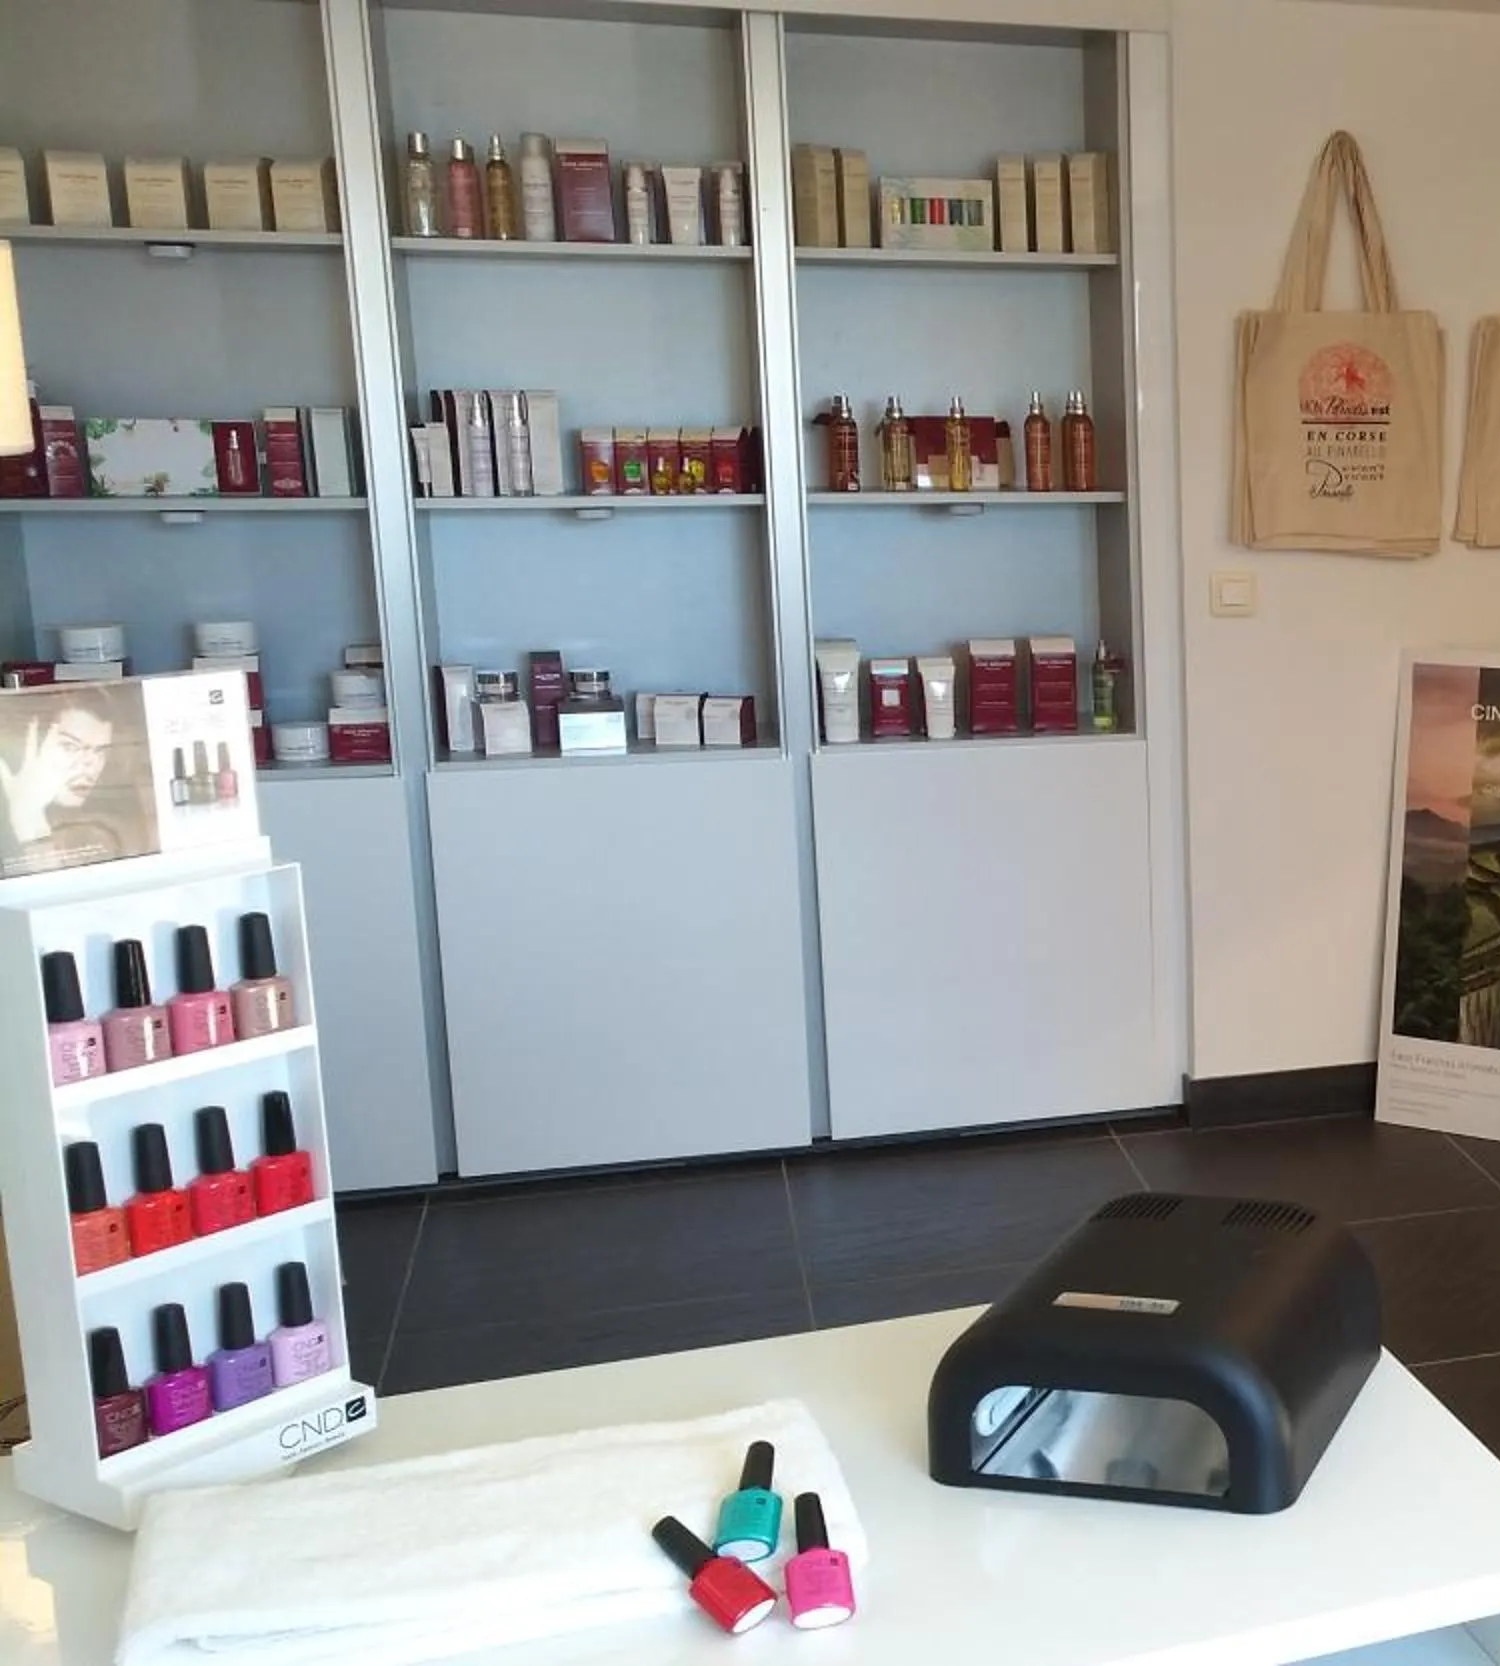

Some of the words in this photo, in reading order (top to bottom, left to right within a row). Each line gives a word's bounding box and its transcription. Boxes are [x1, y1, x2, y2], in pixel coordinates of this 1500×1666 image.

[1307, 431, 1328, 441] EN
[1335, 431, 1387, 442] CORSE
[279, 1406, 345, 1450] CND
